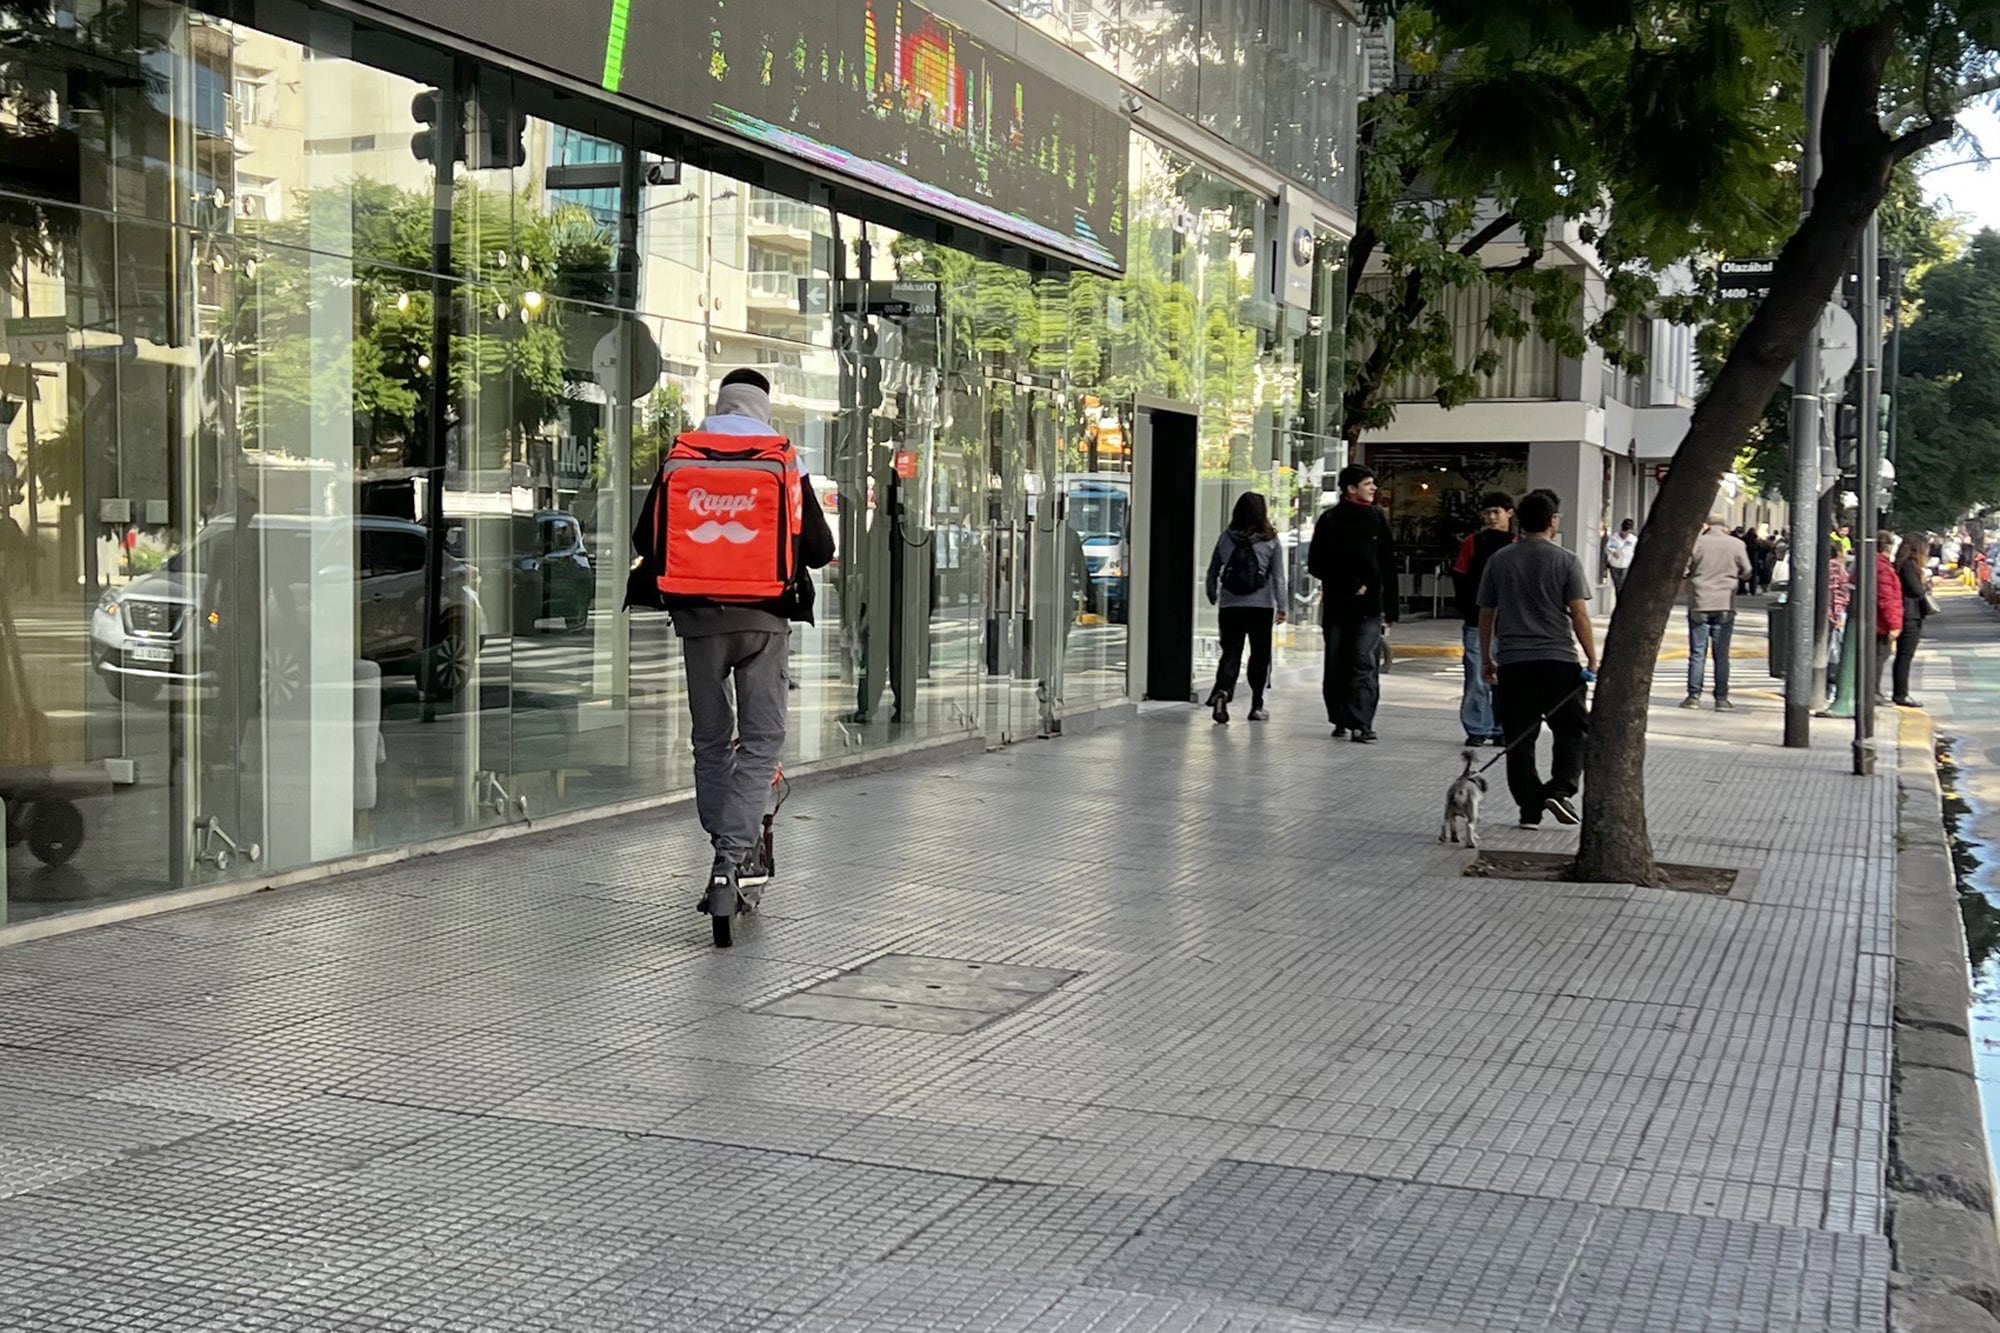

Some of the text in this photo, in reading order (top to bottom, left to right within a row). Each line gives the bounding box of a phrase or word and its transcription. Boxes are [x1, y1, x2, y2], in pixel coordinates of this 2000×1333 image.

[1721, 261, 1773, 273] Olazábal
[1720, 288, 1748, 298] 1400
[687, 487, 758, 518] Rappi
